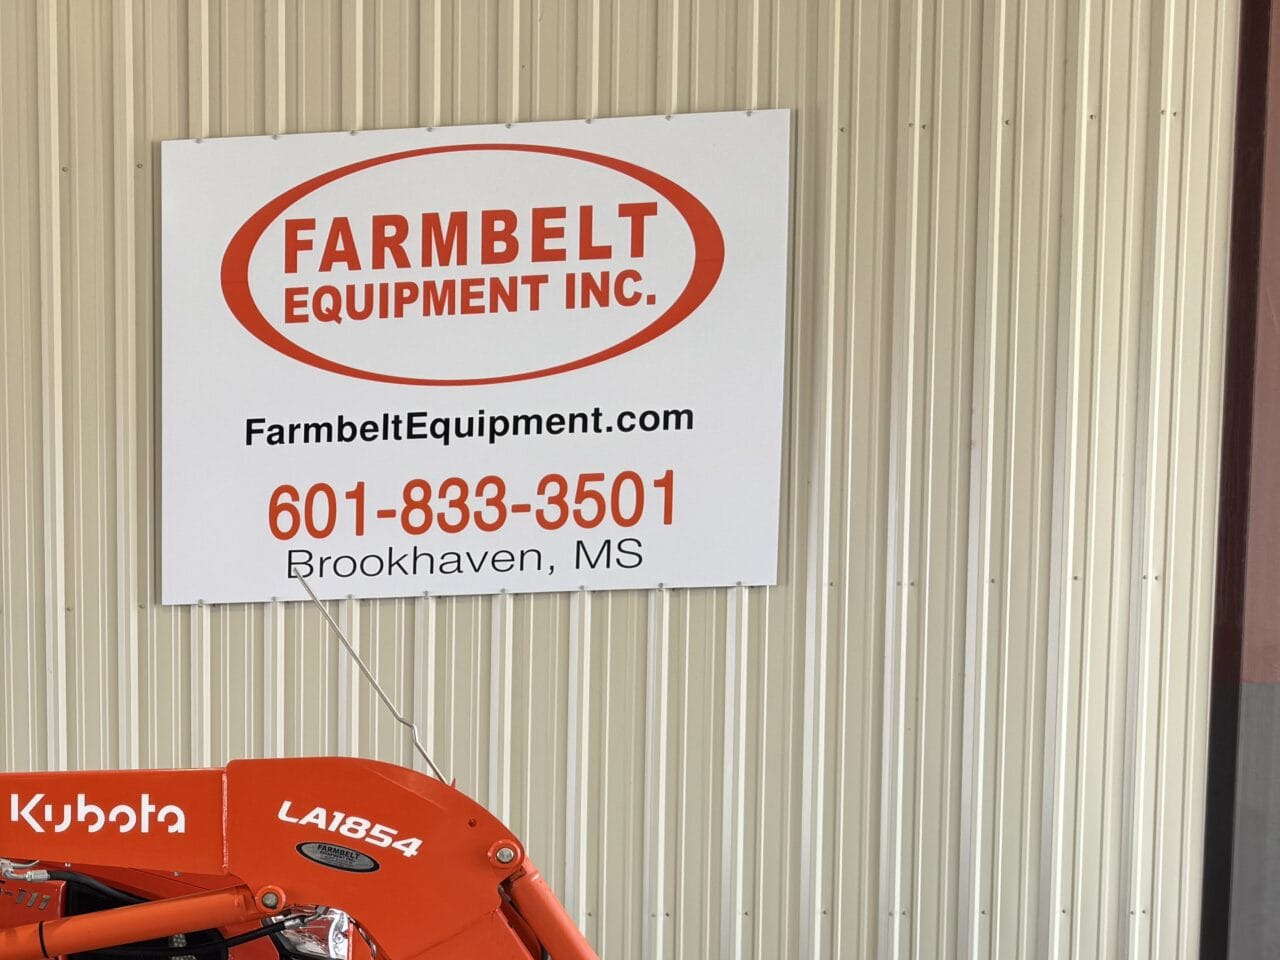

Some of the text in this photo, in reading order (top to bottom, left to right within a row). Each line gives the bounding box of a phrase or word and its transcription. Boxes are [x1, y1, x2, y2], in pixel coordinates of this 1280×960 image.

[283, 201, 659, 274] FARMBELT
[284, 269, 658, 324] EQUIPMENT INC.
[245, 407, 695, 446] FarmbeltEquipment.com
[268, 469, 675, 541] 601-833-3501
[287, 537, 644, 580] Brookhaven, MS
[10, 793, 186, 834] Kubota
[277, 800, 423, 858] LA1854
[317, 844, 361, 860] FARMBELT
